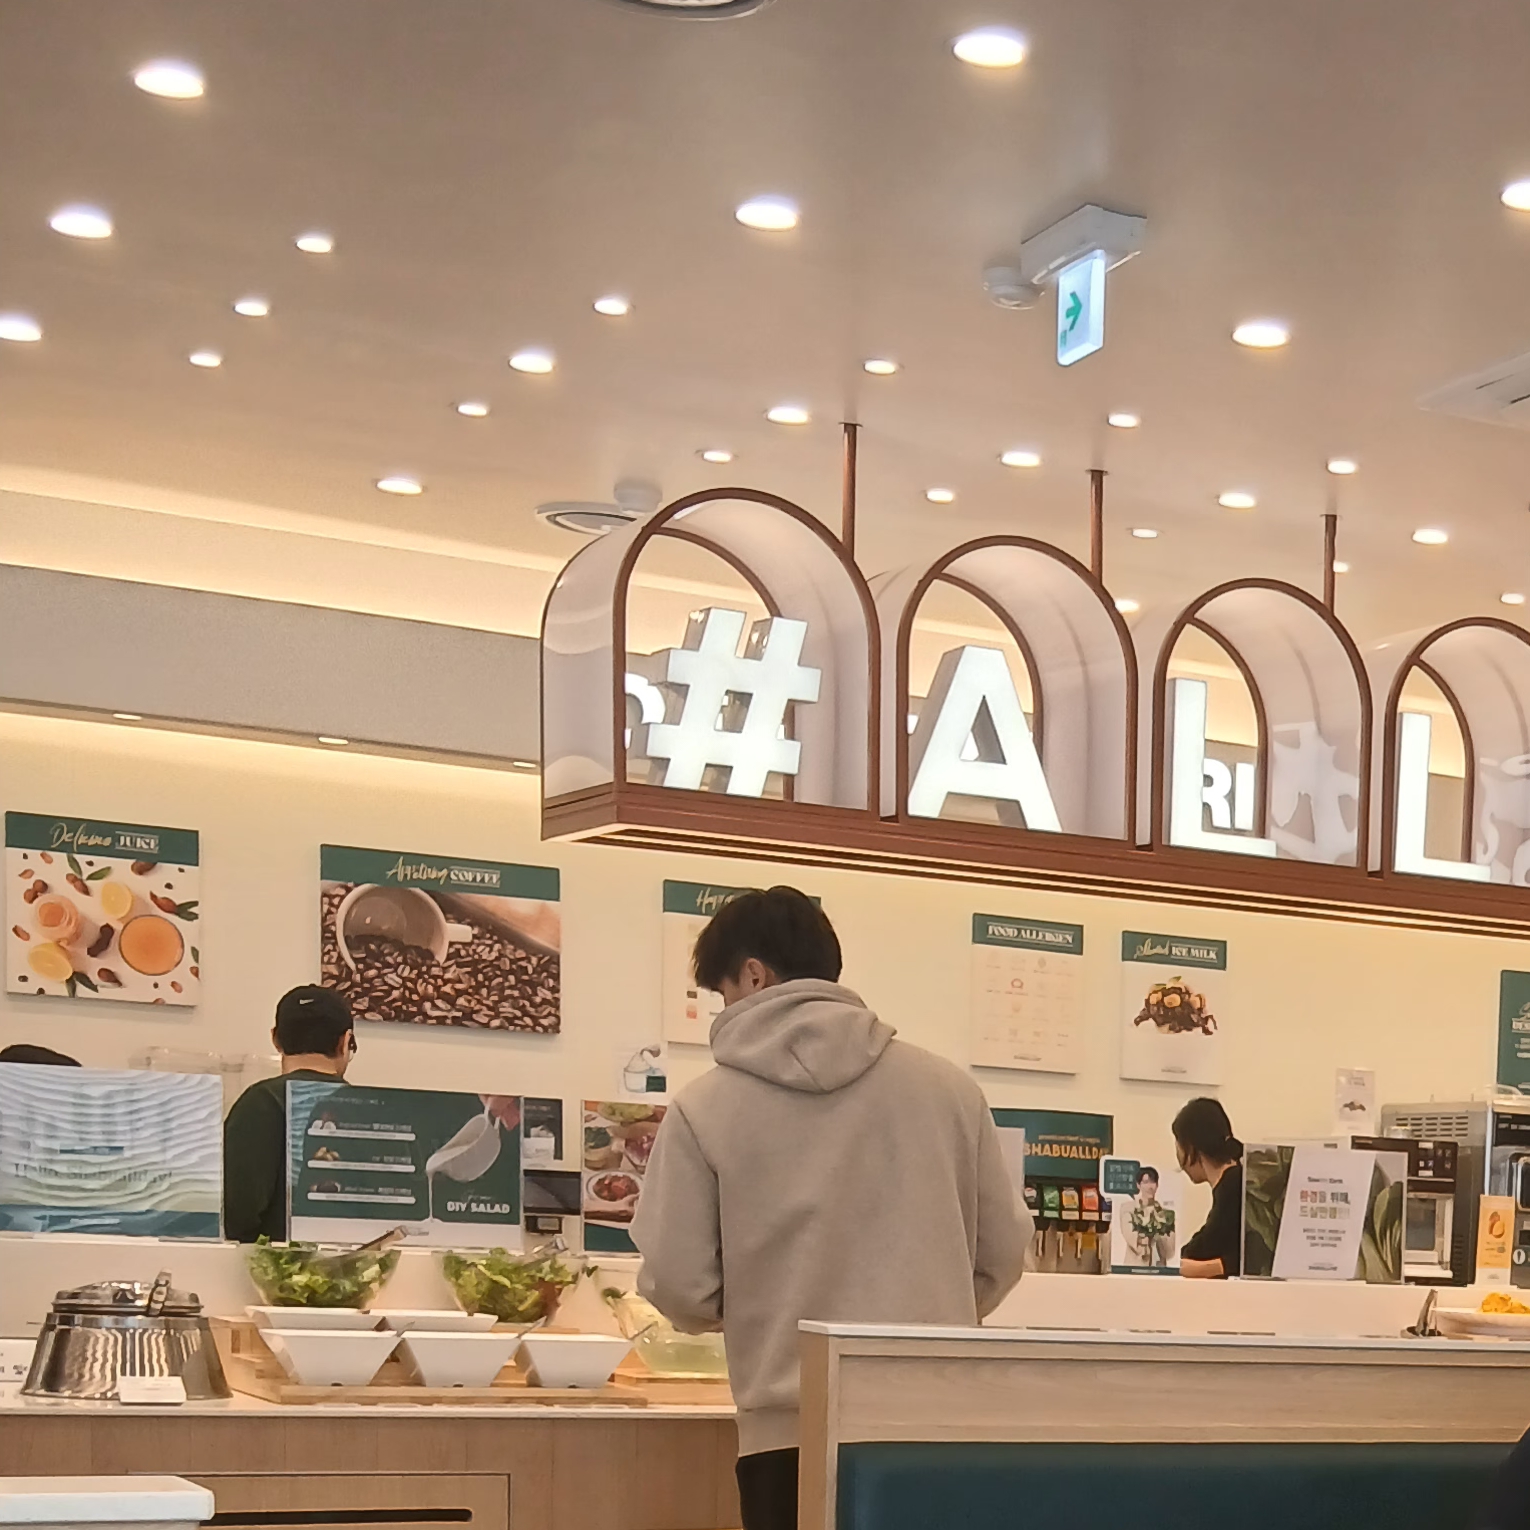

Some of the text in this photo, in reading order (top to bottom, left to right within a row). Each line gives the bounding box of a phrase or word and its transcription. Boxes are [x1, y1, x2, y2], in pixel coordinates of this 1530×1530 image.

[1190, 948, 1217, 960] MILK
[446, 1201, 510, 1214] DIY SALAD
